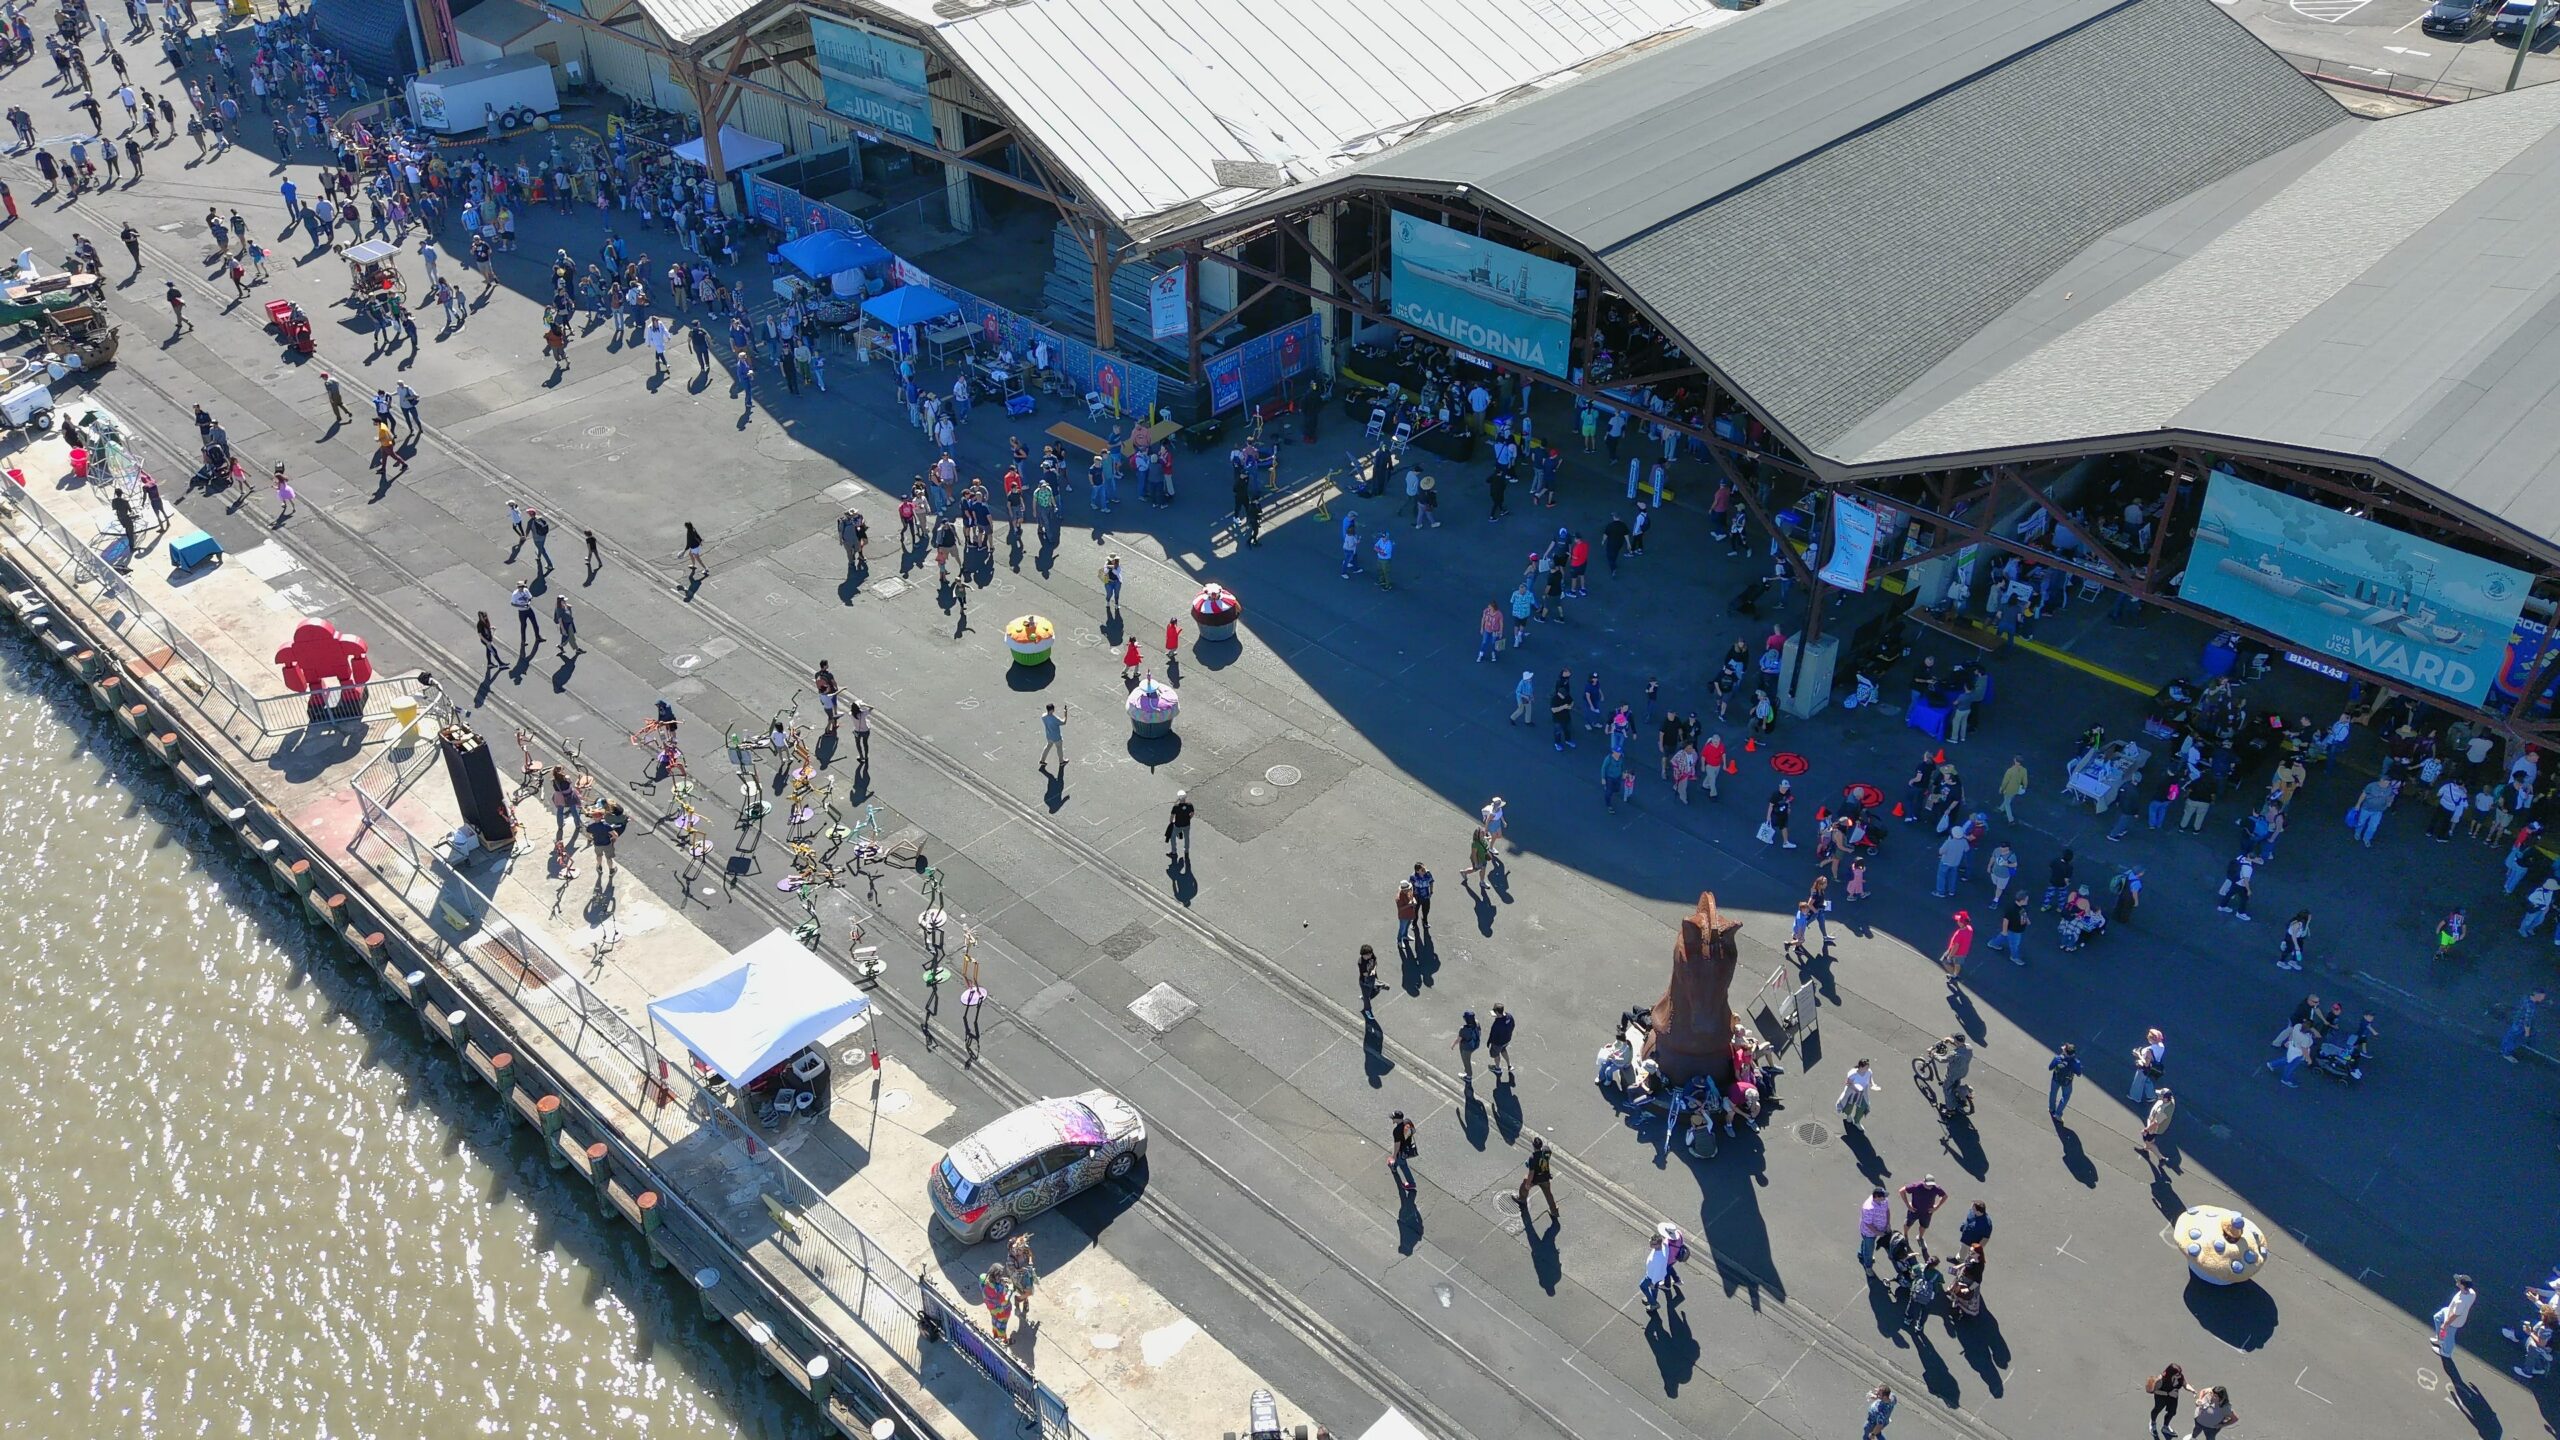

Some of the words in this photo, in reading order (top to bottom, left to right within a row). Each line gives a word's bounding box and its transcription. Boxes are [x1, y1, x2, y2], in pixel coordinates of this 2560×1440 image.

[854, 97, 913, 134] JUPITER
[1408, 302, 1545, 365] CALIFORNIA
[1838, 498, 1853, 509] COAL
[2325, 639, 2350, 655] USS
[2331, 633, 2350, 645] 1918
[2289, 652, 2320, 671] BLDG
[2321, 664, 2343, 679] 143
[2351, 627, 2476, 693] WARD
